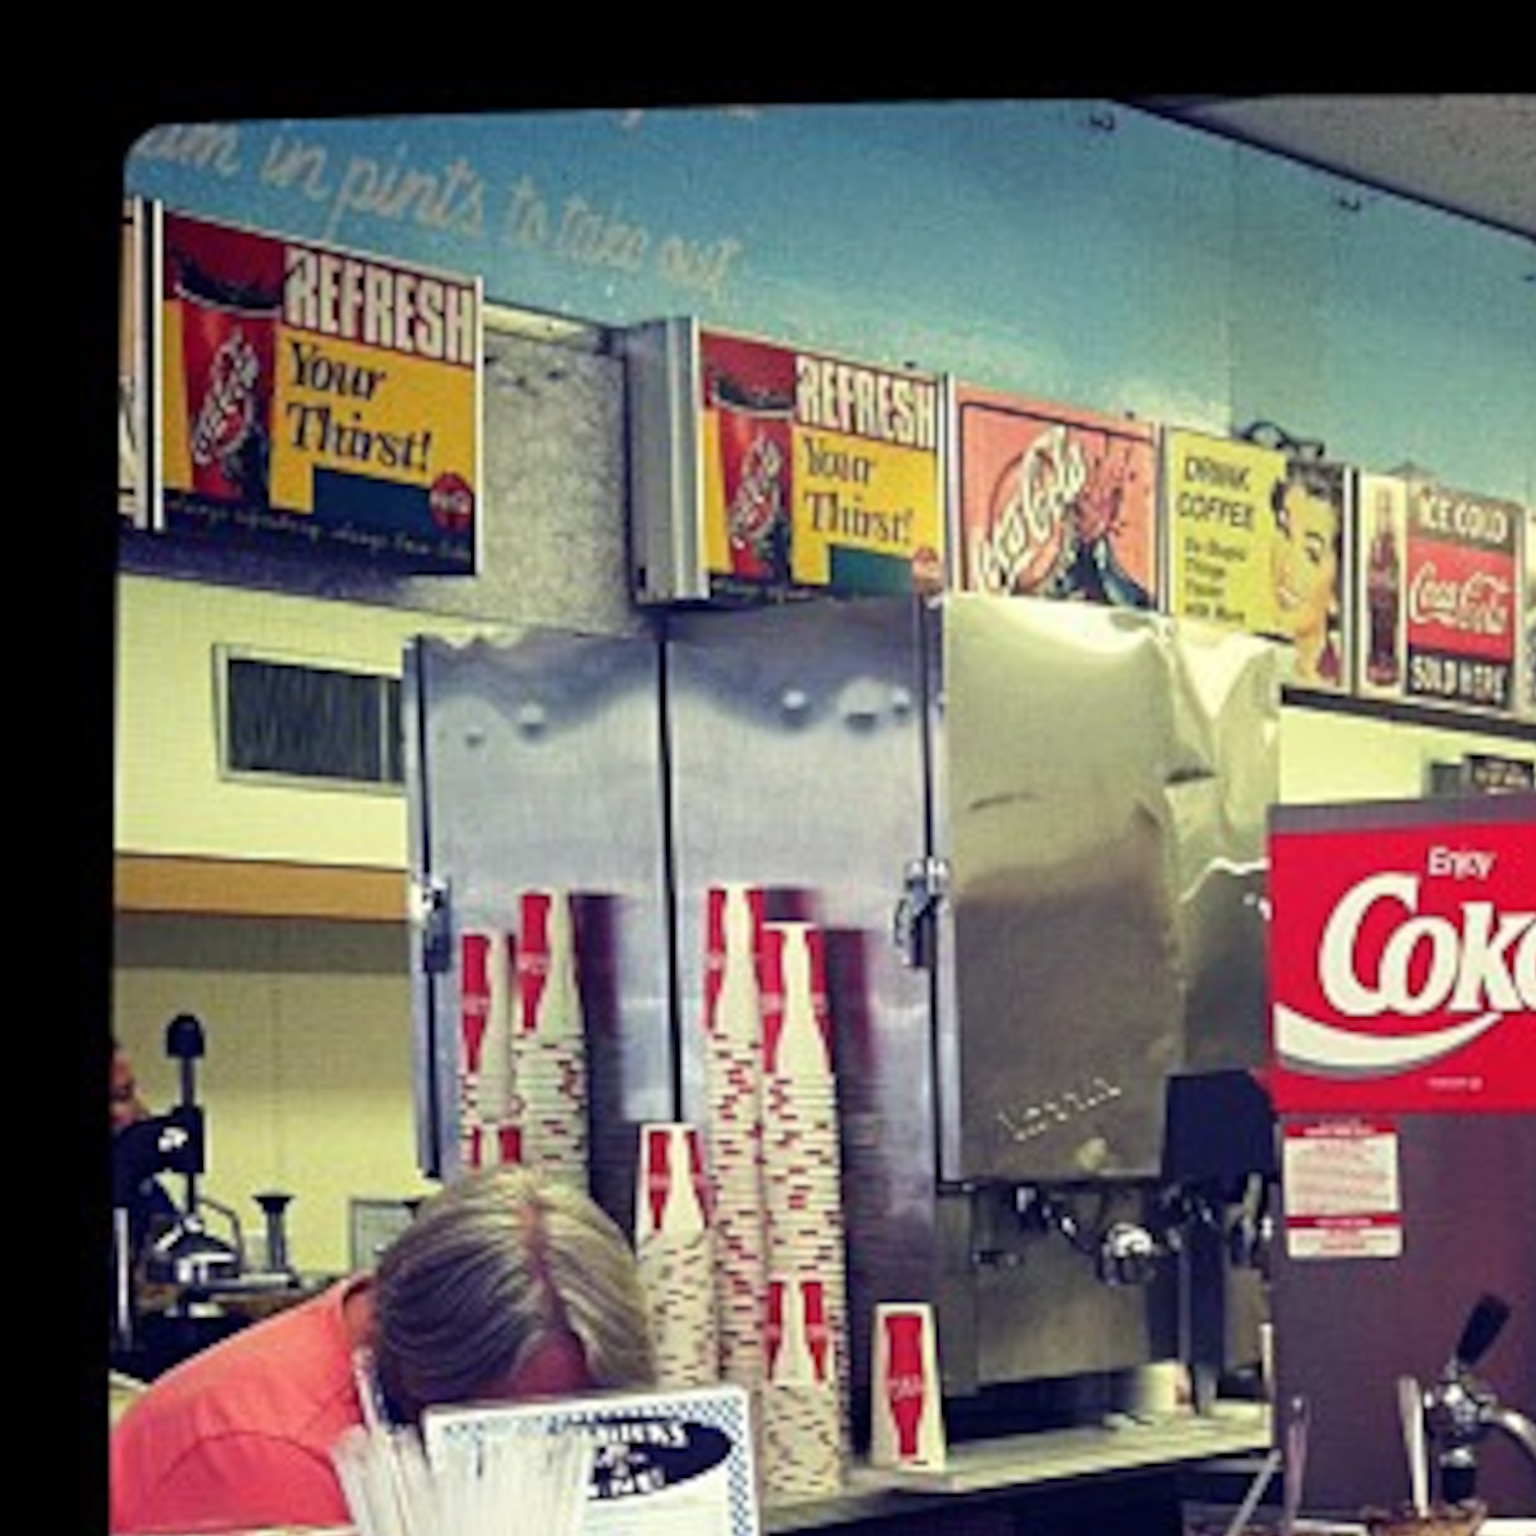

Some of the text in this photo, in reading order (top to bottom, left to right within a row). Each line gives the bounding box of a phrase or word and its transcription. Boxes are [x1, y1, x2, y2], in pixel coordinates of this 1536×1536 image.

[284, 246, 475, 368] REFRESH
[288, 336, 388, 401] Your
[795, 354, 936, 450] REFRESH
[286, 402, 433, 473] Thirst!
[802, 435, 877, 488] Your
[1184, 456, 1252, 494] DRINK
[803, 488, 915, 546] Thirst!
[1176, 490, 1256, 534] COFFEE
[1428, 844, 1499, 882] Enjoy
